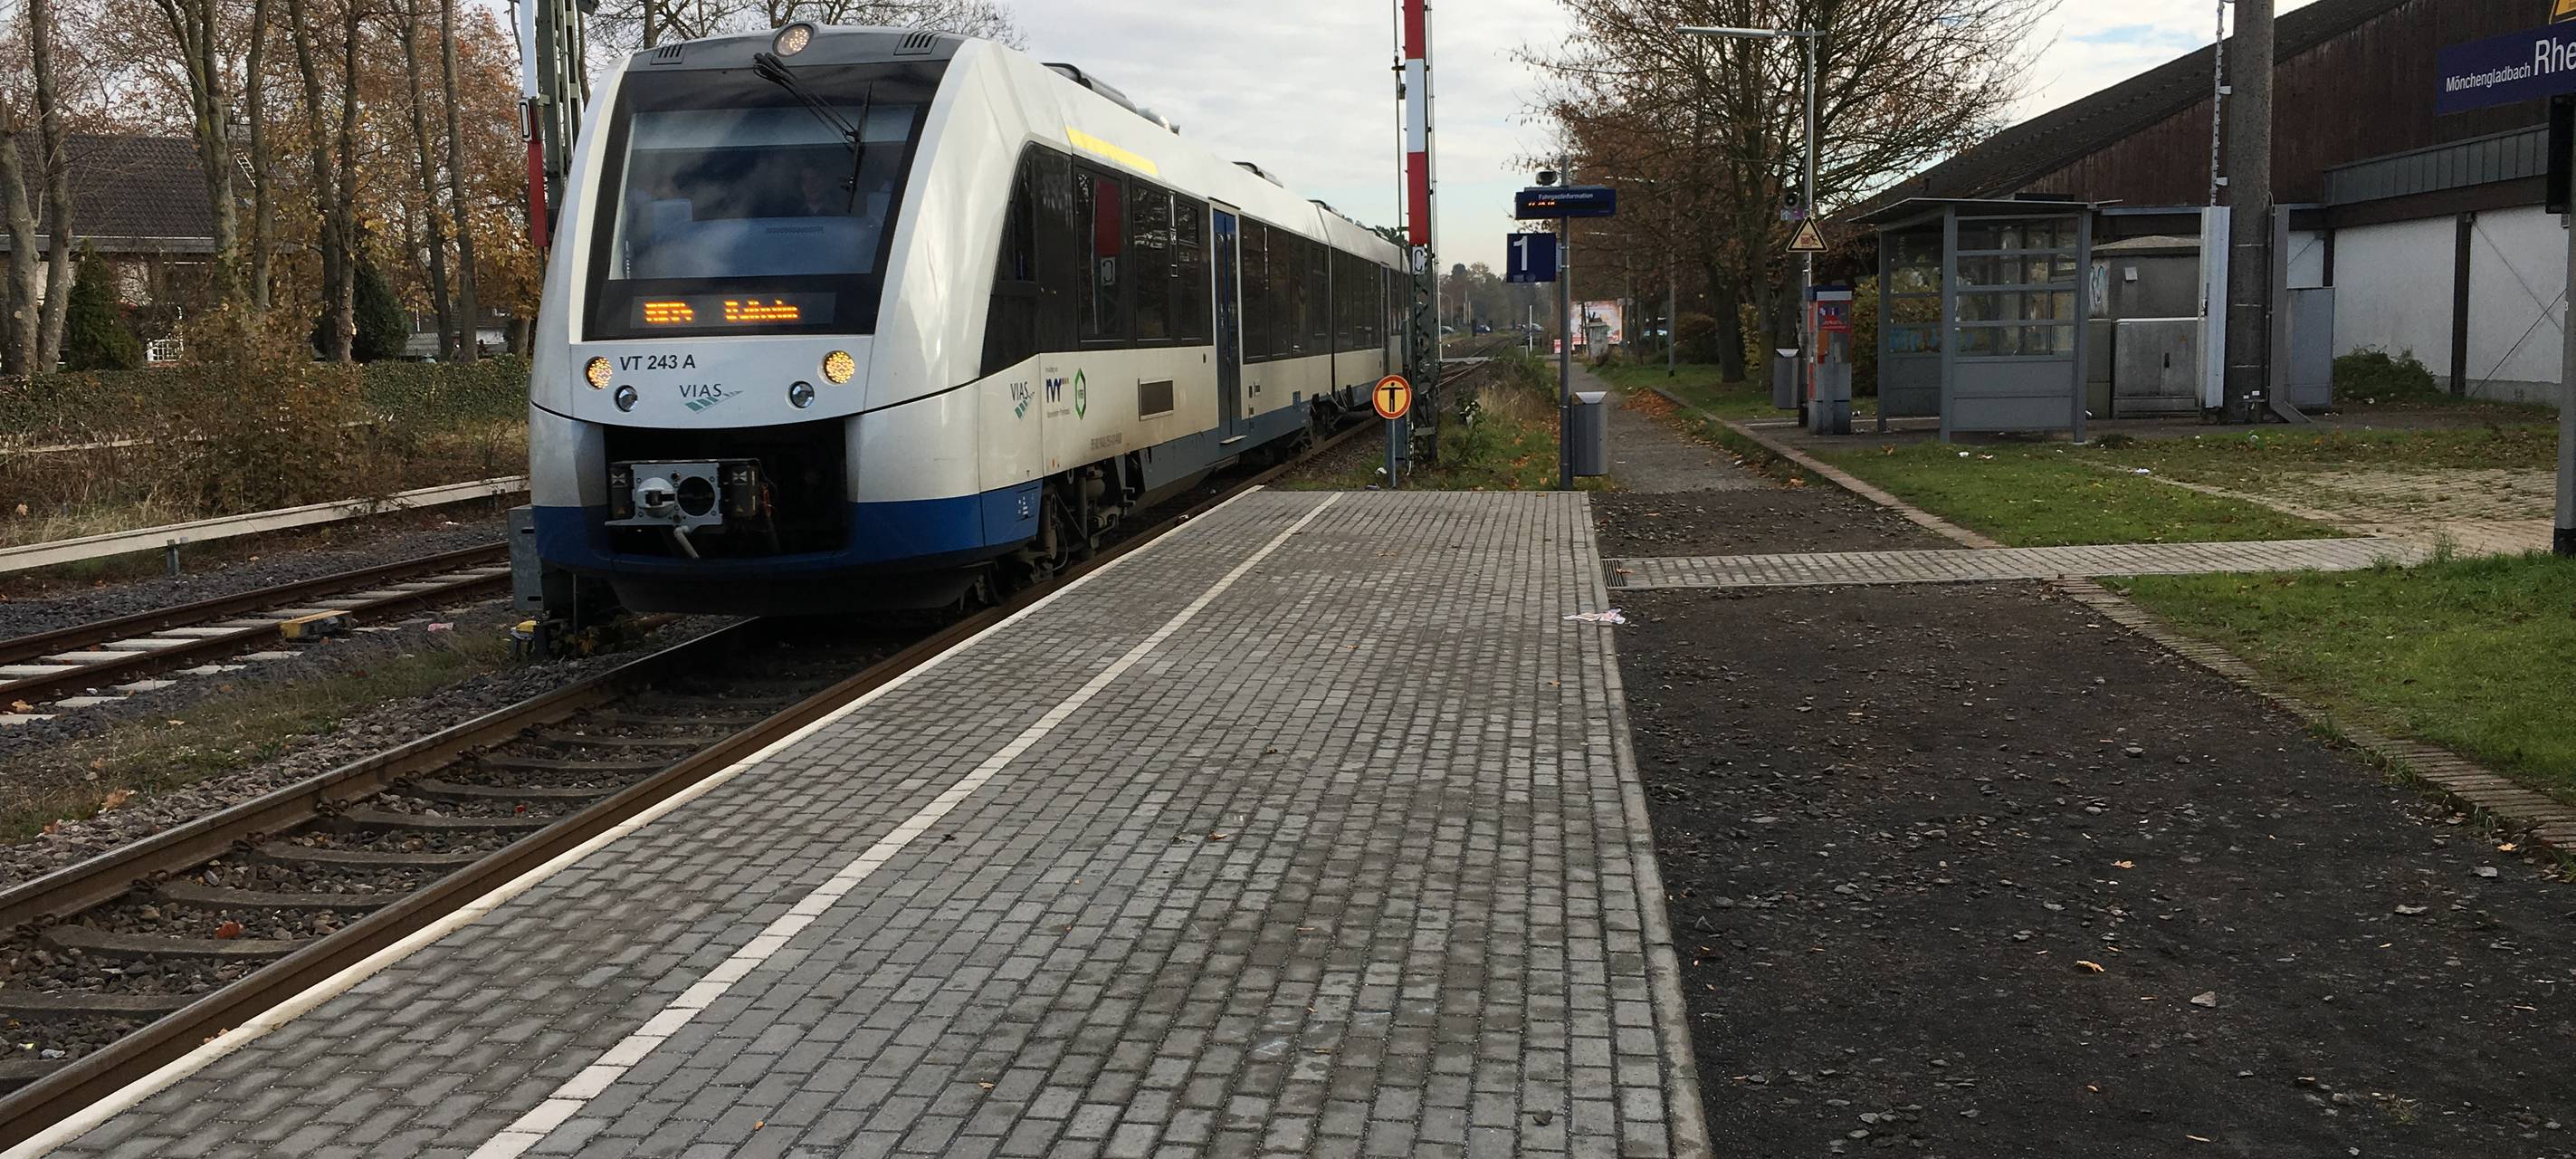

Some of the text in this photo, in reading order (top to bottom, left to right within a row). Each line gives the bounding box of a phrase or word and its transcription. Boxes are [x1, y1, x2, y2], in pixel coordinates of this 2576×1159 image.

[2446, 62, 2531, 92] Mönchengladbach
[1538, 193, 1594, 201] Fahrgastinformation
[1512, 235, 1528, 271] 1
[619, 354, 696, 371] VT 243 A
[679, 383, 722, 398] VIAS
[1010, 380, 1029, 401] VIAS
